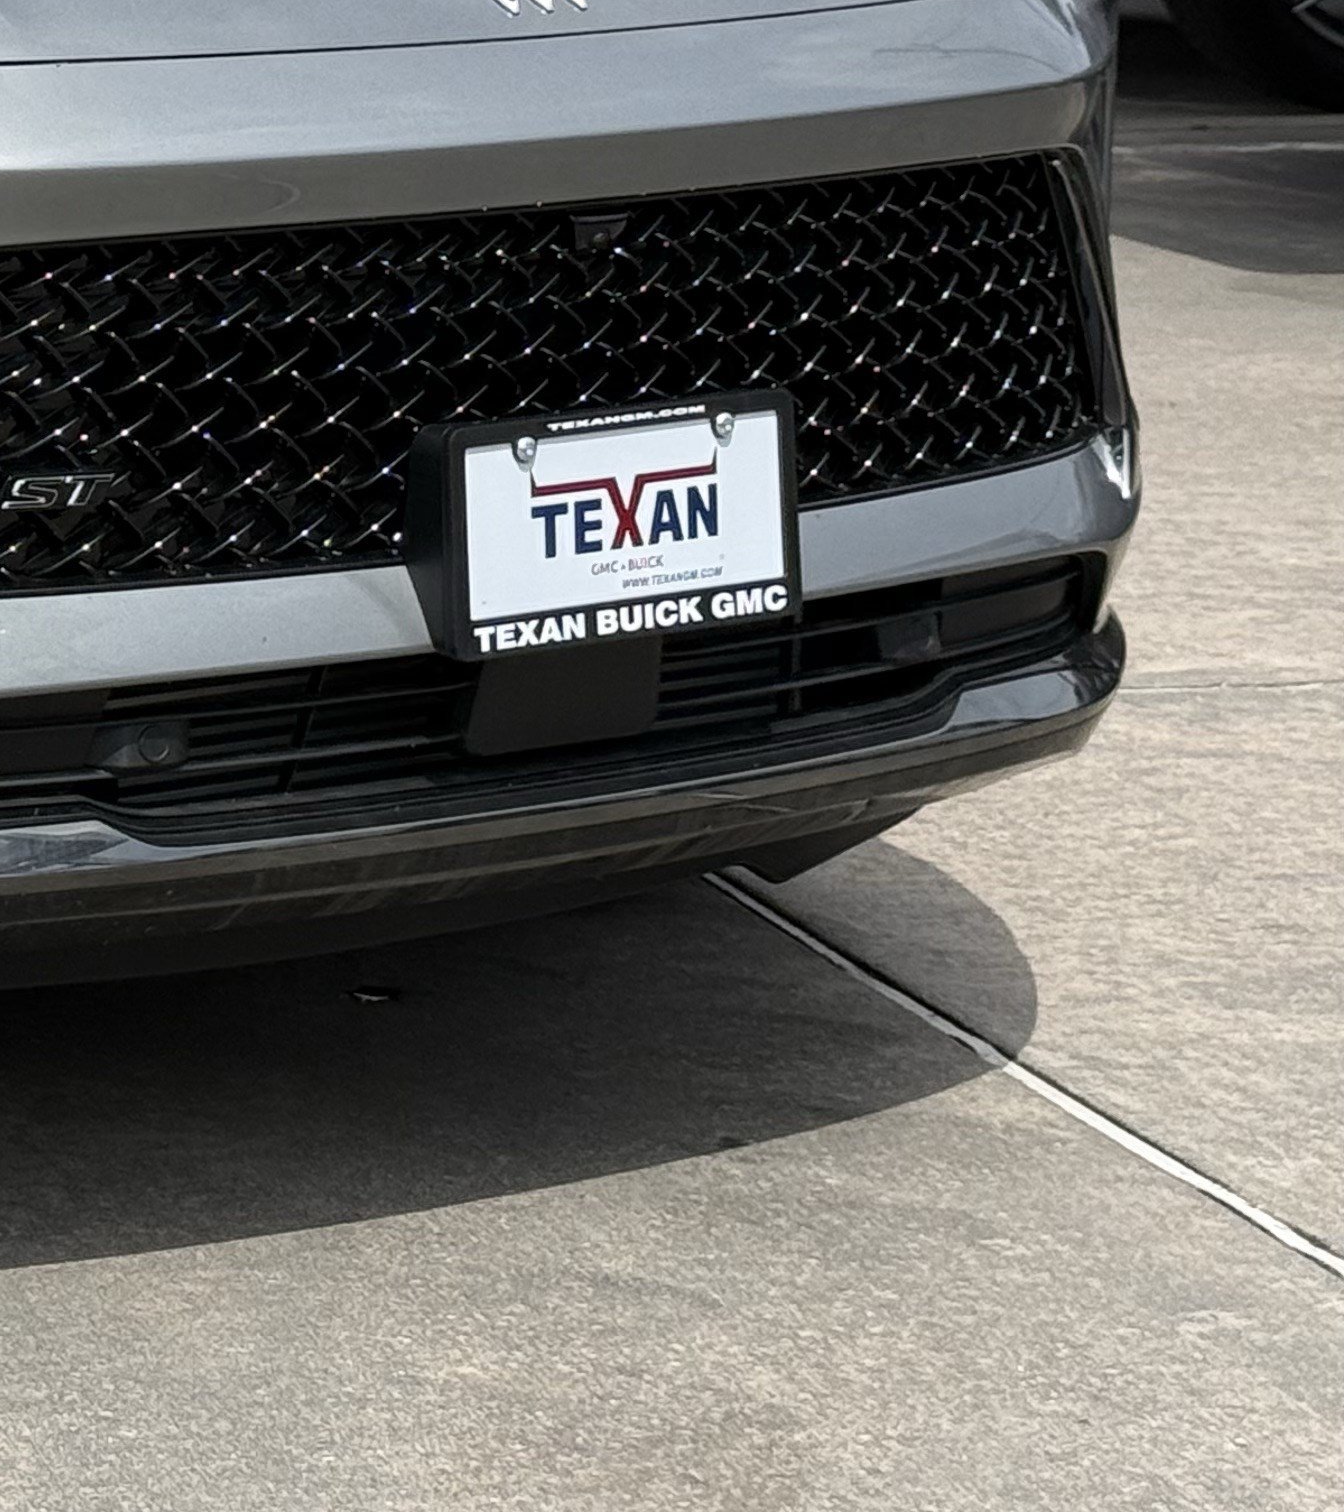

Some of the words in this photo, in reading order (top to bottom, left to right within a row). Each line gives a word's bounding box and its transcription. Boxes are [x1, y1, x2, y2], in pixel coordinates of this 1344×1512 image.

[547, 404, 706, 433] TEXANGM.COM
[0, 472, 116, 510] ST
[531, 474, 718, 559] TEXAN
[590, 558, 620, 576] GMC
[473, 613, 586, 653] TEXAN
[597, 596, 703, 636] BUICK
[711, 584, 788, 620] GMC
